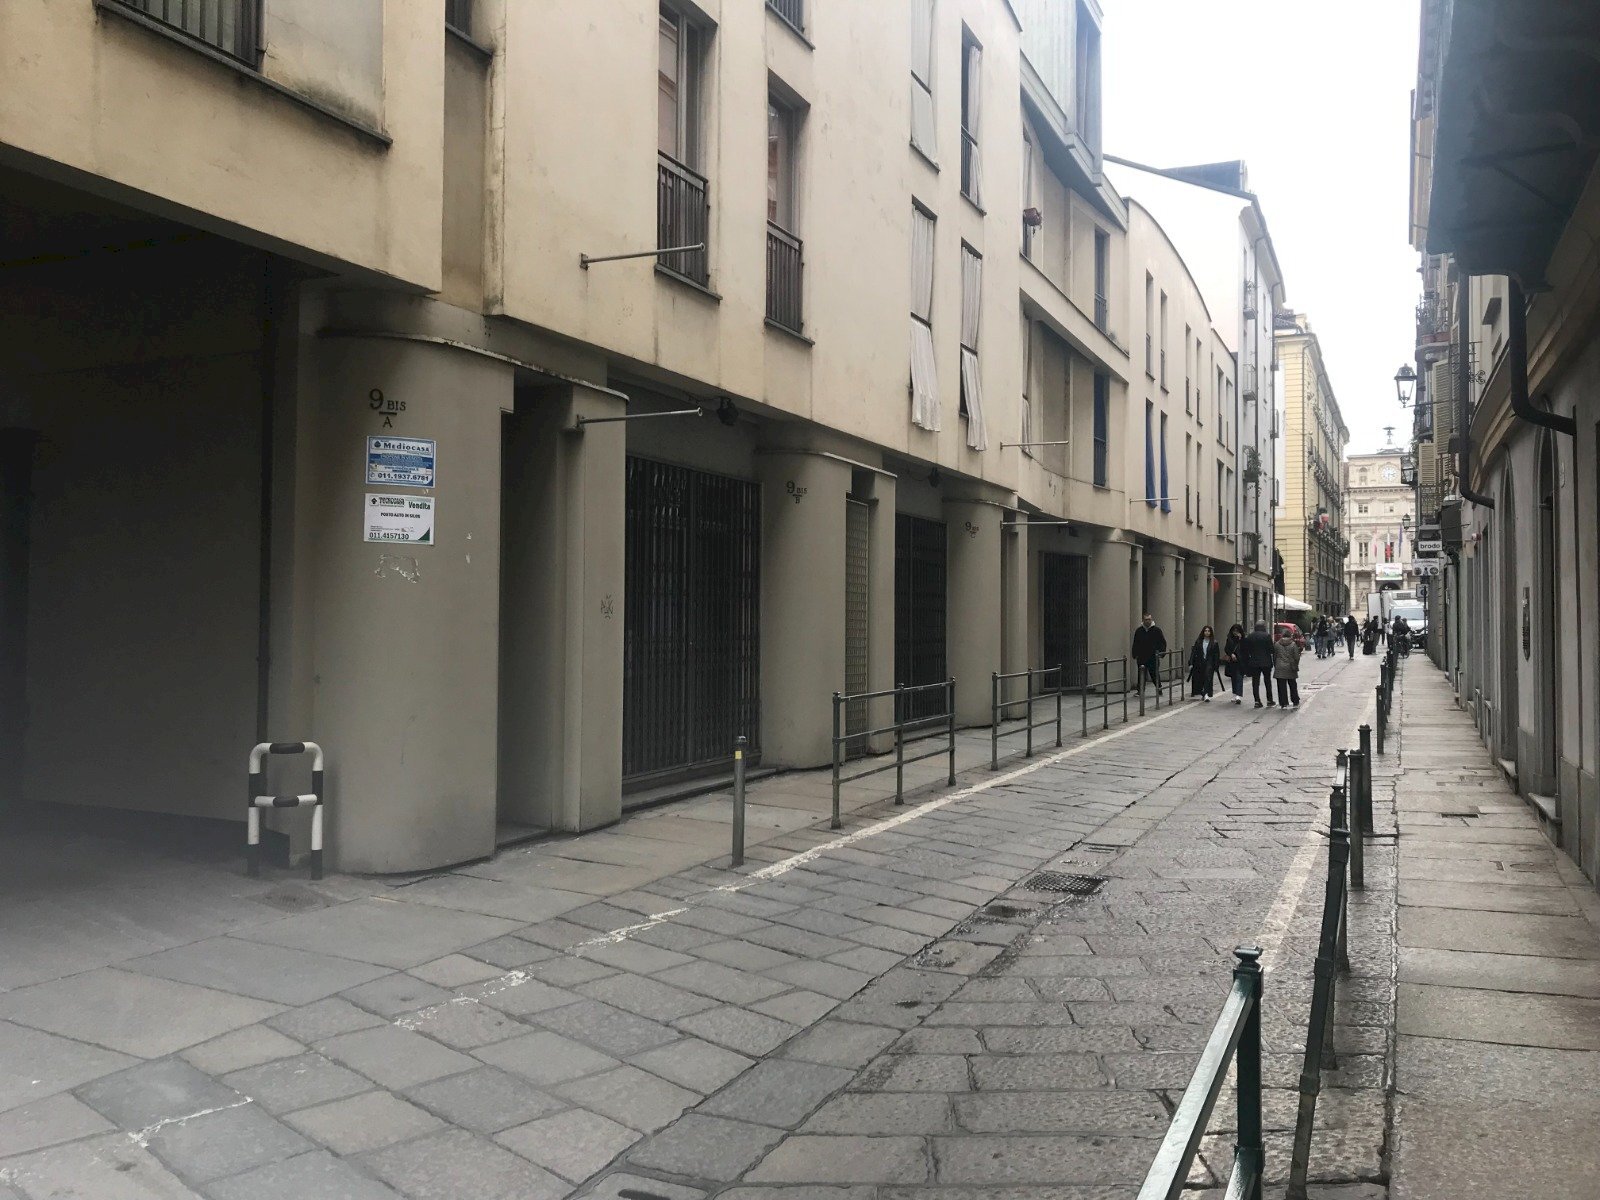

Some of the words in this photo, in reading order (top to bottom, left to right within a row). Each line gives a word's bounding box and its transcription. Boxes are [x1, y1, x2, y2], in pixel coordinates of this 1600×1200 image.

[369, 388, 384, 410] 9
[387, 400, 406, 411] BIS
[382, 415, 393, 428] A
[377, 472, 429, 481] 011.1937.6781
[786, 480, 795, 494] 9
[408, 501, 431, 510] Vendita
[965, 521, 972, 531] 9
[369, 532, 409, 540] 011.4157130
